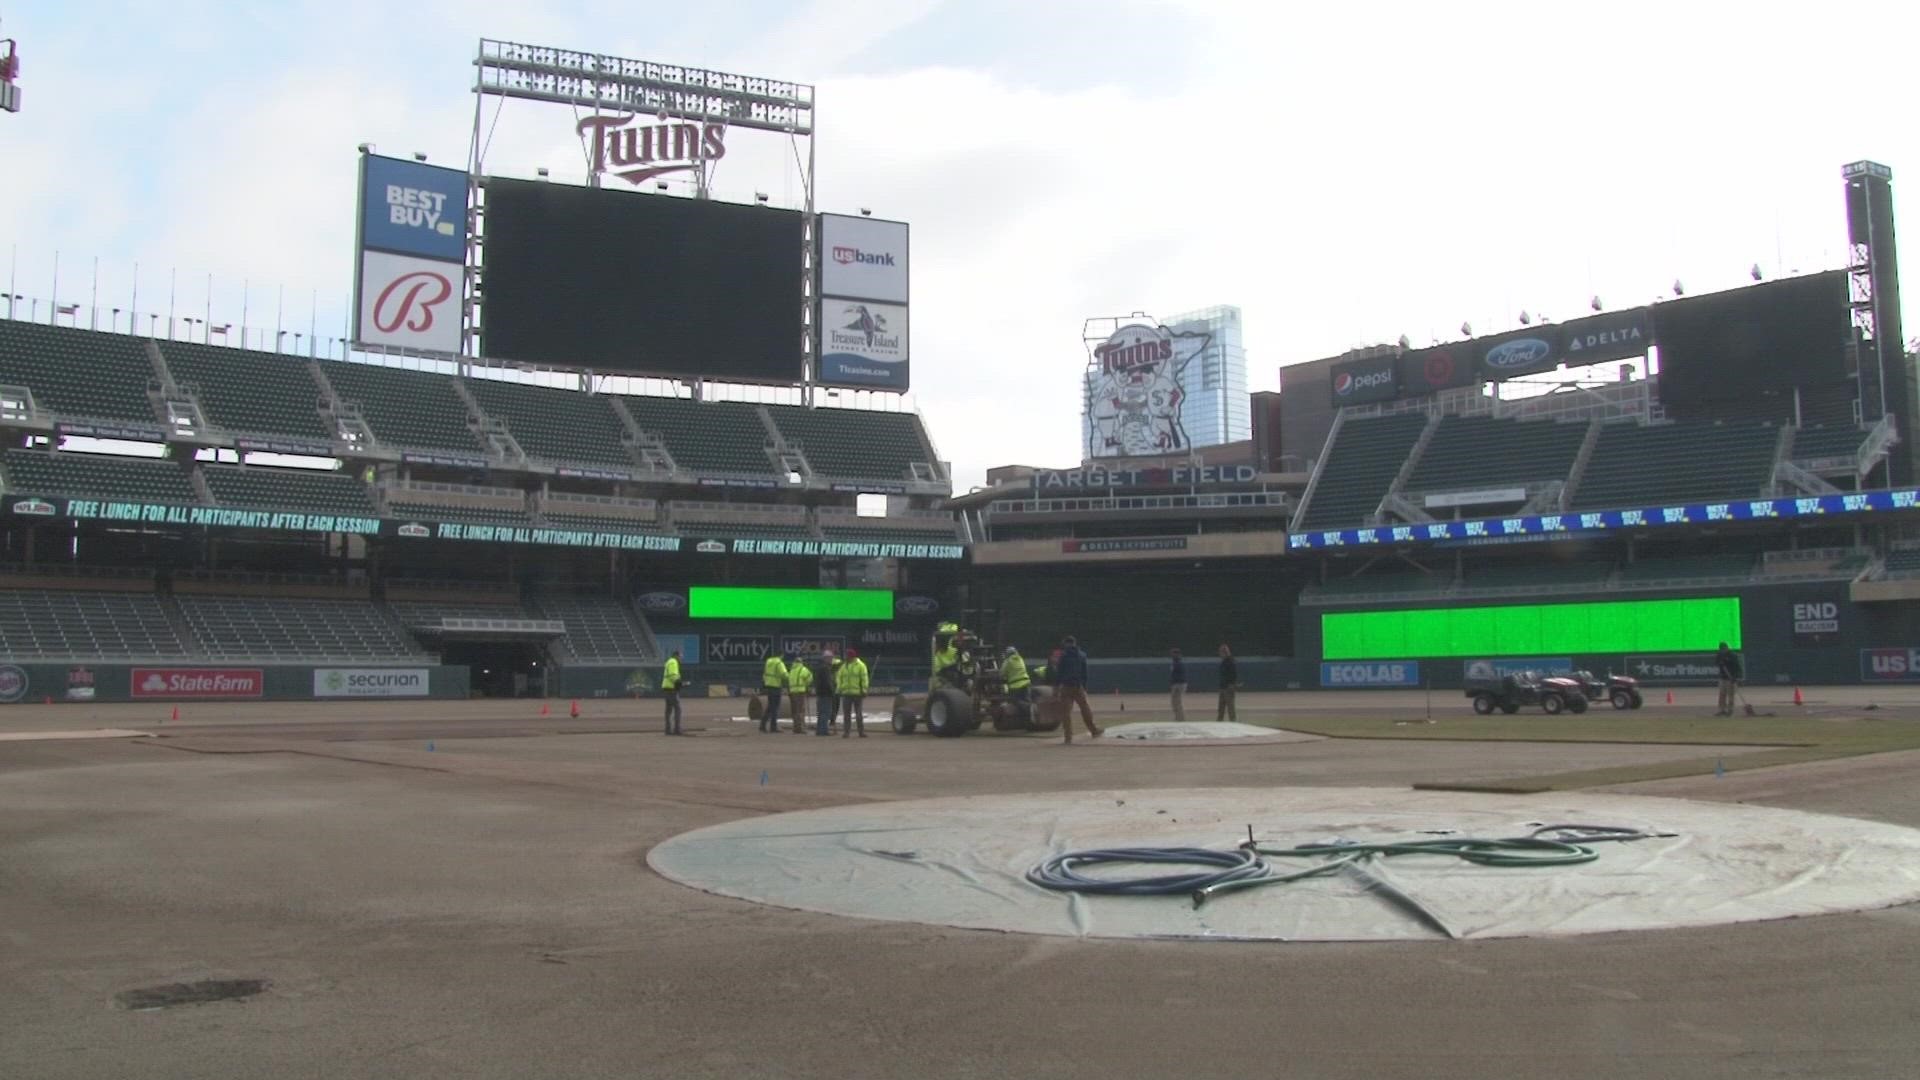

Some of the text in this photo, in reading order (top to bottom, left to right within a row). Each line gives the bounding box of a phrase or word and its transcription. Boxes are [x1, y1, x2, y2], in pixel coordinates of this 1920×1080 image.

[576, 110, 726, 173] Twins
[387, 184, 447, 212] BEST
[390, 204, 441, 230] BUY
[832, 246, 895, 266] usbank
[373, 271, 453, 334] B
[831, 330, 899, 349] Treasure Island
[1586, 328, 1641, 348] DELTA
[1094, 337, 1171, 377] Twins
[1498, 345, 1536, 364] Ford
[1354, 368, 1392, 390] pepsi
[1033, 465, 1256, 487] TARGET FIELD
[66, 500, 99, 518] FREE
[100, 502, 139, 520] LUNCH
[141, 503, 166, 521] FOR
[166, 505, 188, 523] ALL
[190, 508, 271, 528] PARTICIPANTS
[270, 513, 304, 530] AFTER
[305, 515, 334, 532] EACH
[335, 517, 380, 535] SESSION
[437, 523, 461, 538] FREE
[463, 525, 494, 540] LUNCH
[494, 527, 513, 542] FOR
[513, 528, 529, 543] ALL
[532, 528, 593, 546] PARTICIPANTS
[593, 532, 621, 548] AFTER
[621, 534, 643, 549] EACH
[644, 536, 680, 551] SESSION
[732, 539, 755, 553] FREE
[756, 540, 785, 554] LUNCH
[785, 541, 802, 555] FOR
[803, 542, 819, 555] ALL
[820, 542, 879, 557] PARTICIPANTS
[879, 543, 905, 558] AFTER
[906, 544, 928, 558] EACH
[928, 545, 964, 560] SESSION
[1794, 603, 1837, 620] END
[711, 638, 769, 660] xfinity
[348, 673, 419, 687] securian
[1330, 665, 1405, 682] ECOLAB
